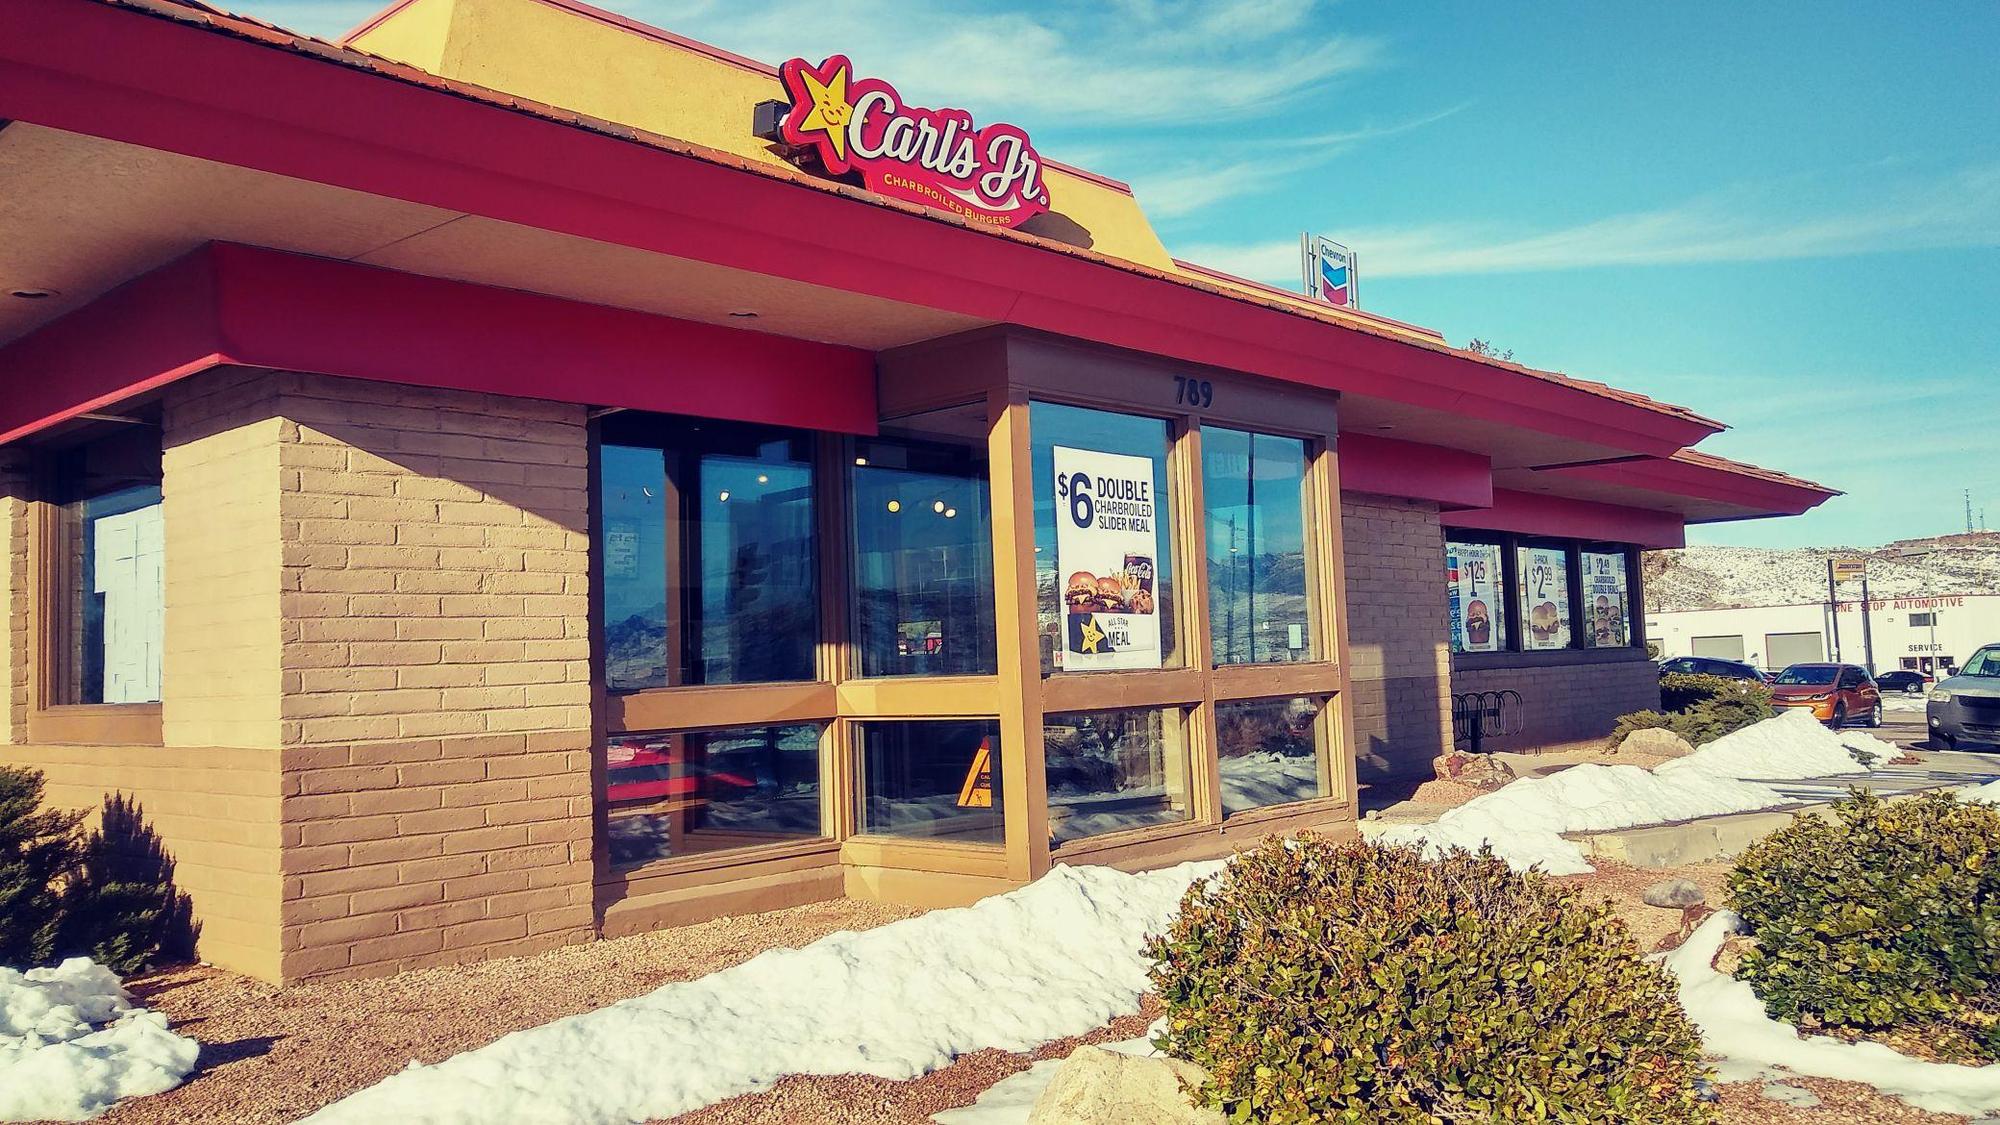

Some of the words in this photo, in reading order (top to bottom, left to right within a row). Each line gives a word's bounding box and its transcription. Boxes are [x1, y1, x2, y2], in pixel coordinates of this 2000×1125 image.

[849, 90, 981, 179] Carl's
[884, 173, 963, 213] CHARBROILED
[965, 208, 1012, 224] BURGERS
[1321, 244, 1346, 262] Chevron
[1174, 375, 1213, 408] 789
[1097, 477, 1149, 502] DOUBLE
[1094, 500, 1153, 517] CHARBROILED
[1098, 516, 1127, 531] SLIDER
[1128, 517, 1151, 533] MEAL
[1834, 603, 1853, 613] ONE
[1860, 602, 1886, 612] STOP
[1893, 597, 1964, 610] AUTOMOTIVE
[1117, 617, 1129, 627] STAR
[1108, 631, 1131, 646] MEAL
[1908, 644, 1943, 652] SERVICE
